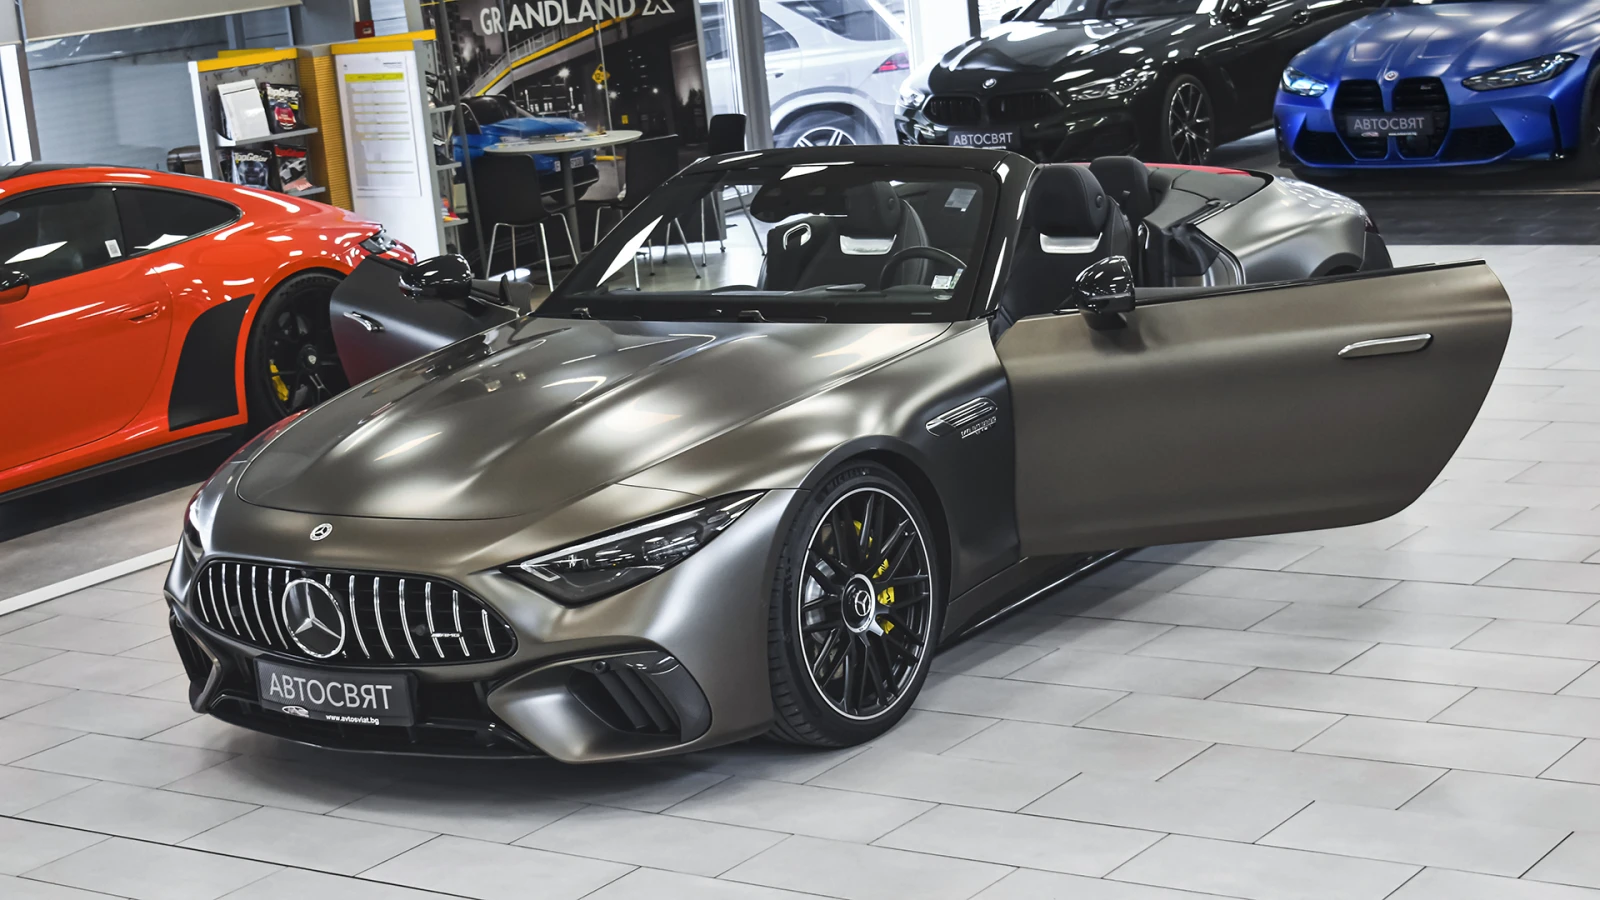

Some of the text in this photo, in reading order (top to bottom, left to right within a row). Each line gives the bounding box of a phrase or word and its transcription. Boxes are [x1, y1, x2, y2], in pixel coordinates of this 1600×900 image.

[480, 0, 636, 35] GRANDLAND
[1353, 117, 1425, 131] АВТОСВЯТ
[953, 132, 1013, 146] АВТОСВЯТ
[269, 672, 393, 710] АВТОСВЯТ
[325, 714, 380, 726] www.avtosviat.bg
